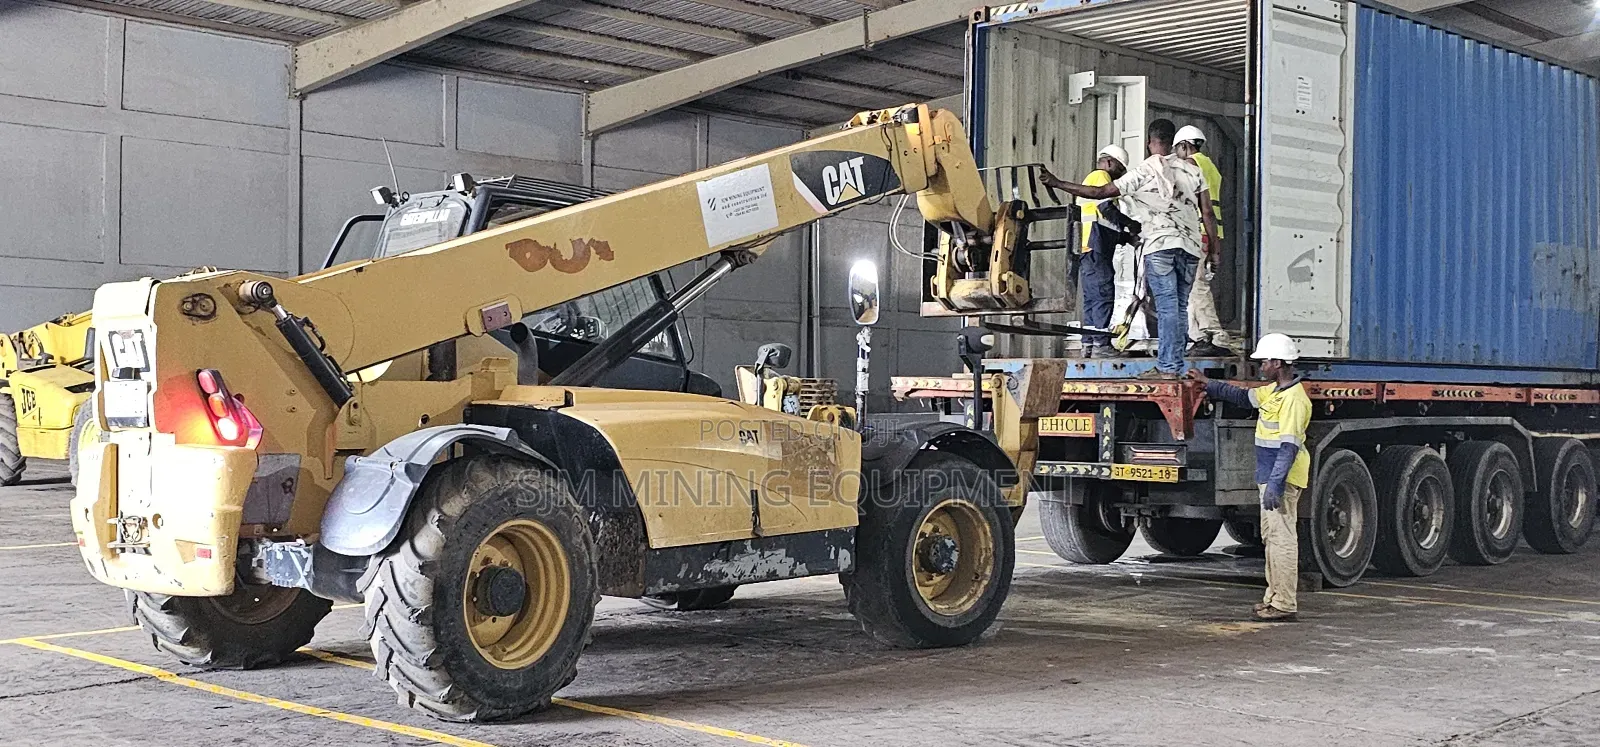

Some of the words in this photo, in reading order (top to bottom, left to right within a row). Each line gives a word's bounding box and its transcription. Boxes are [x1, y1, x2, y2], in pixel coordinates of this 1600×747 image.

[822, 155, 866, 206] CAT
[21, 387, 36, 415] JCB
[1041, 418, 1091, 431] EHICLE
[739, 430, 759, 445] CAT
[1130, 467, 1171, 479] 9521-18
